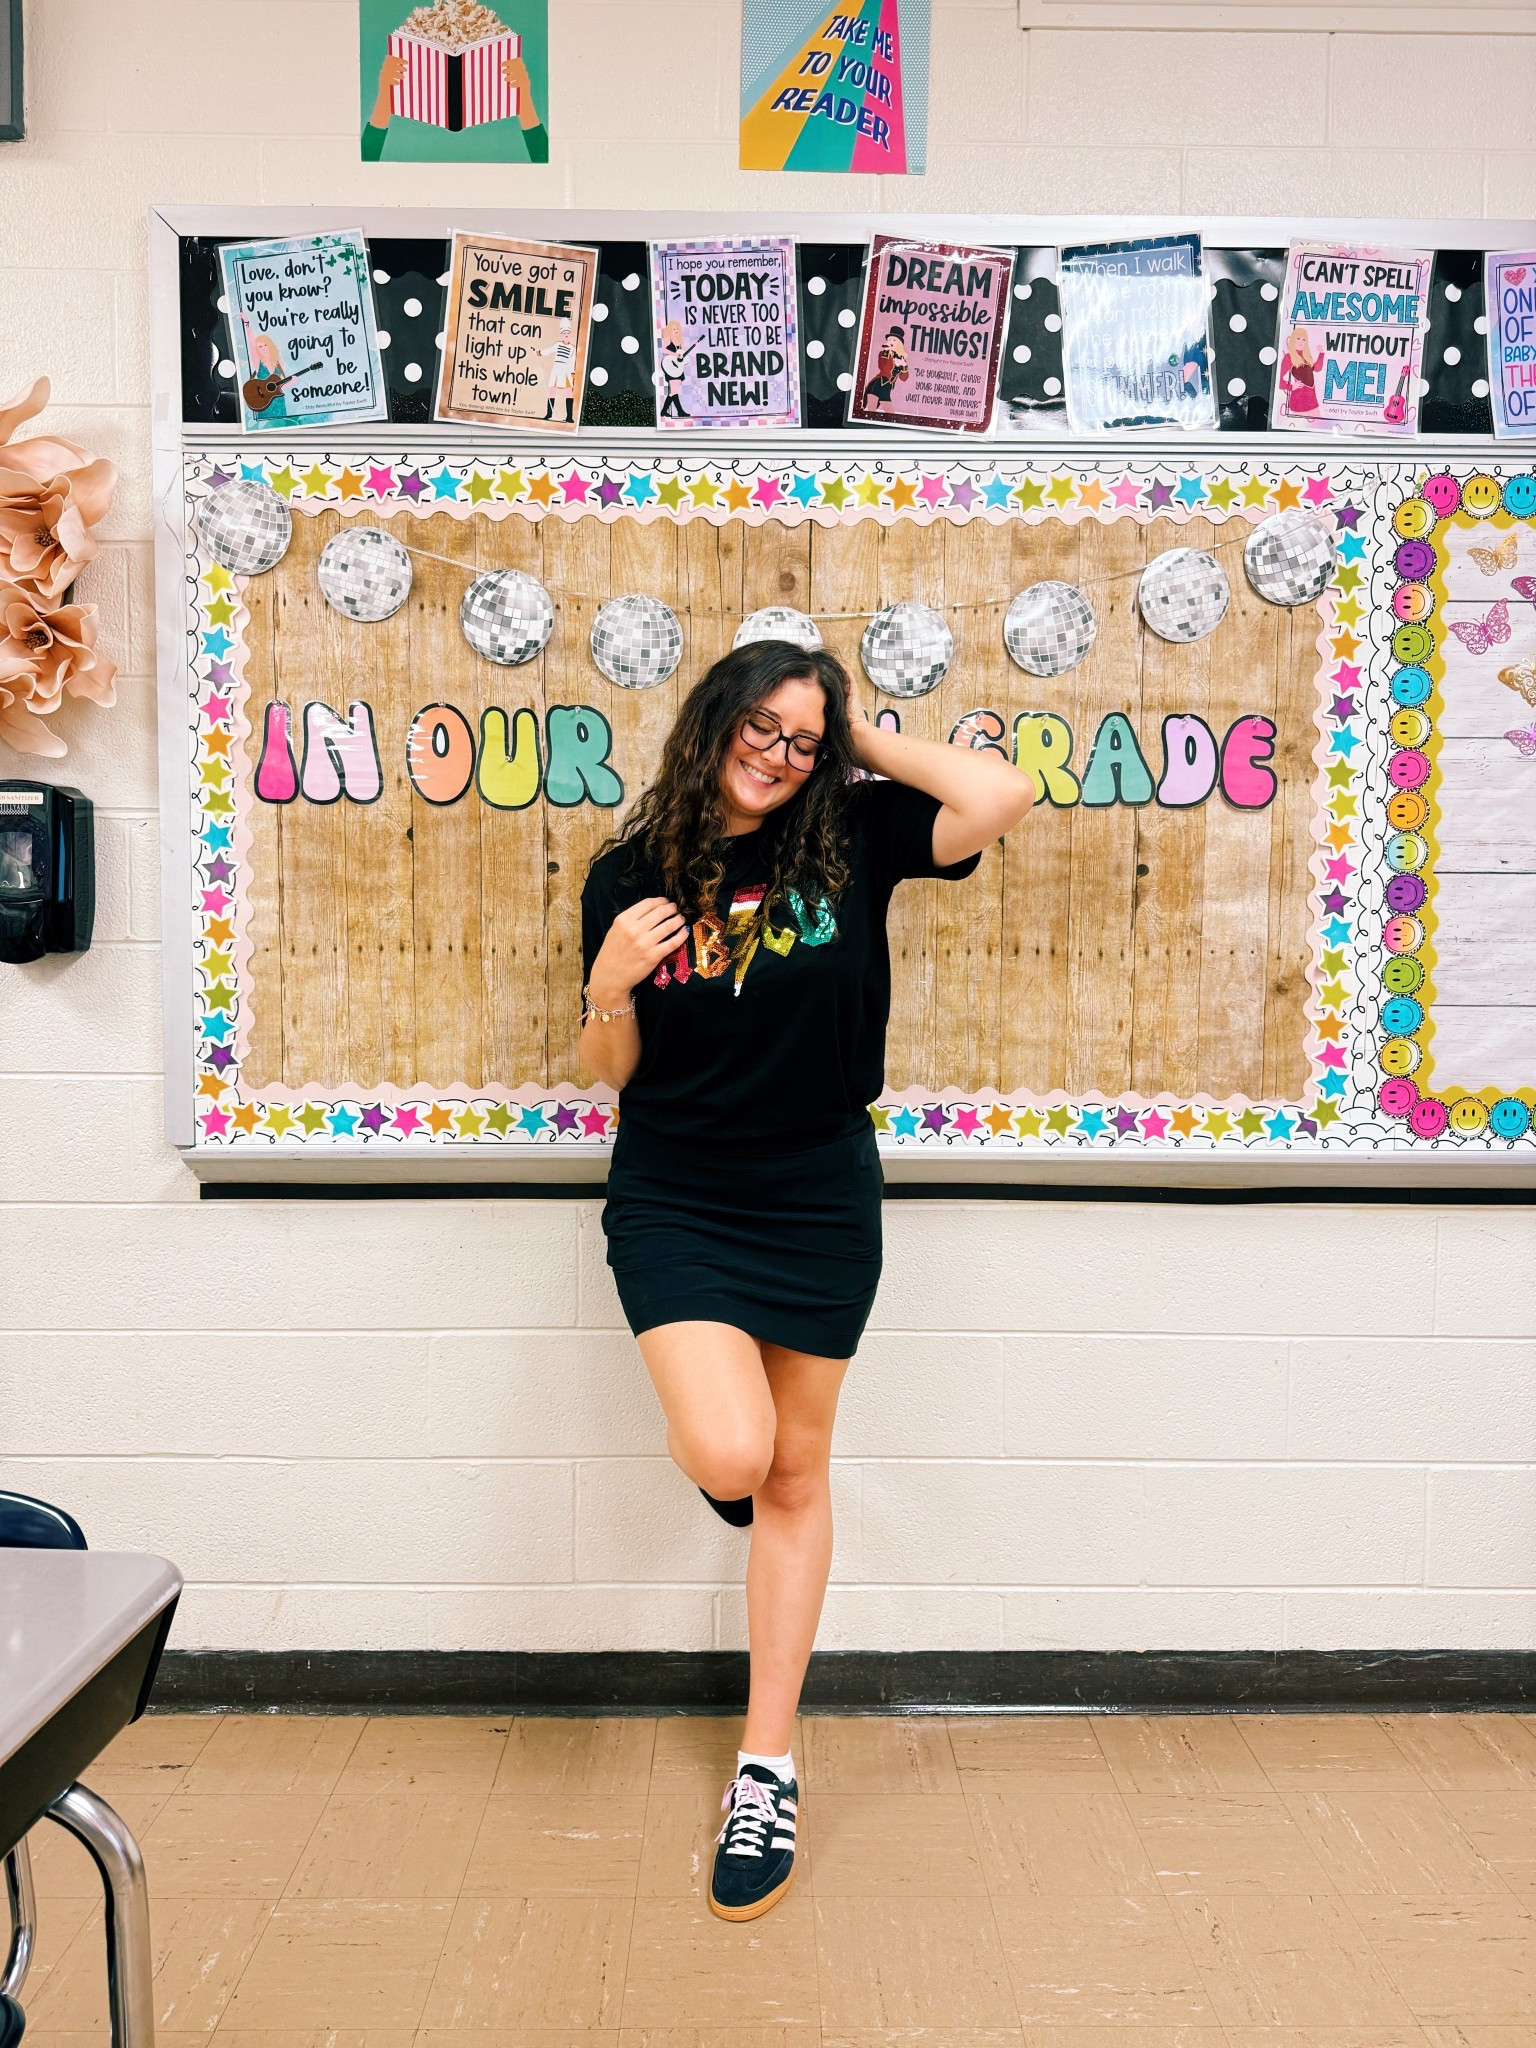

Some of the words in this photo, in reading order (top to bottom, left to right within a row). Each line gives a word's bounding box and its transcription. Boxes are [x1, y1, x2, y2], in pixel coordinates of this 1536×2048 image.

[822, 15, 870, 45] TAKE
[871, 27, 894, 63] ME
[799, 51, 832, 76] TO
[838, 55, 892, 109] YOUR
[771, 87, 890, 153] READER
[285, 254, 326, 278] don't
[474, 252, 522, 276] You've
[528, 263, 558, 284] got
[563, 270, 575, 283] a
[668, 259, 673, 270] I
[676, 258, 702, 272] hope
[705, 259, 725, 271] you
[728, 254, 781, 268] remember,
[886, 254, 993, 298] DREAM
[1078, 262, 1128, 277] When
[1135, 257, 1140, 274] I
[1147, 251, 1186, 272] walk
[1303, 260, 1360, 284] CAN'T
[1363, 265, 1414, 290] SPELL
[245, 290, 272, 312] you
[279, 276, 332, 302] know?
[467, 278, 575, 319] SMILE
[681, 272, 770, 302] TODAY
[1504, 287, 1536, 314] ON
[257, 308, 309, 332] You're
[314, 300, 359, 325] really
[685, 306, 697, 325] IS
[702, 304, 746, 324] NEVER
[752, 303, 779, 322] TOO
[879, 294, 992, 325] impossible
[1291, 291, 1420, 323] AWESOME
[468, 312, 505, 333] that
[510, 322, 542, 339] can
[708, 328, 740, 347] LATE
[744, 326, 761, 346] TO
[766, 326, 782, 345] BE
[1505, 316, 1534, 343] OF
[288, 334, 333, 360] going
[338, 327, 356, 348] to
[465, 334, 503, 360] light
[508, 346, 526, 364] up
[910, 324, 989, 360] THINGS!
[1325, 332, 1409, 357] WITHOUT
[336, 358, 357, 375] be
[458, 360, 487, 381] this
[493, 364, 538, 386] whole
[696, 350, 784, 378] BRAND
[291, 372, 370, 402] someone!
[472, 384, 518, 406] town!
[707, 381, 769, 406] NEW!
[1086, 370, 1187, 408] SIMMER!
[1323, 359, 1387, 403] ME!
[1508, 390, 1536, 416] OF
[254, 700, 385, 806] IN
[406, 701, 625, 811] OUR
